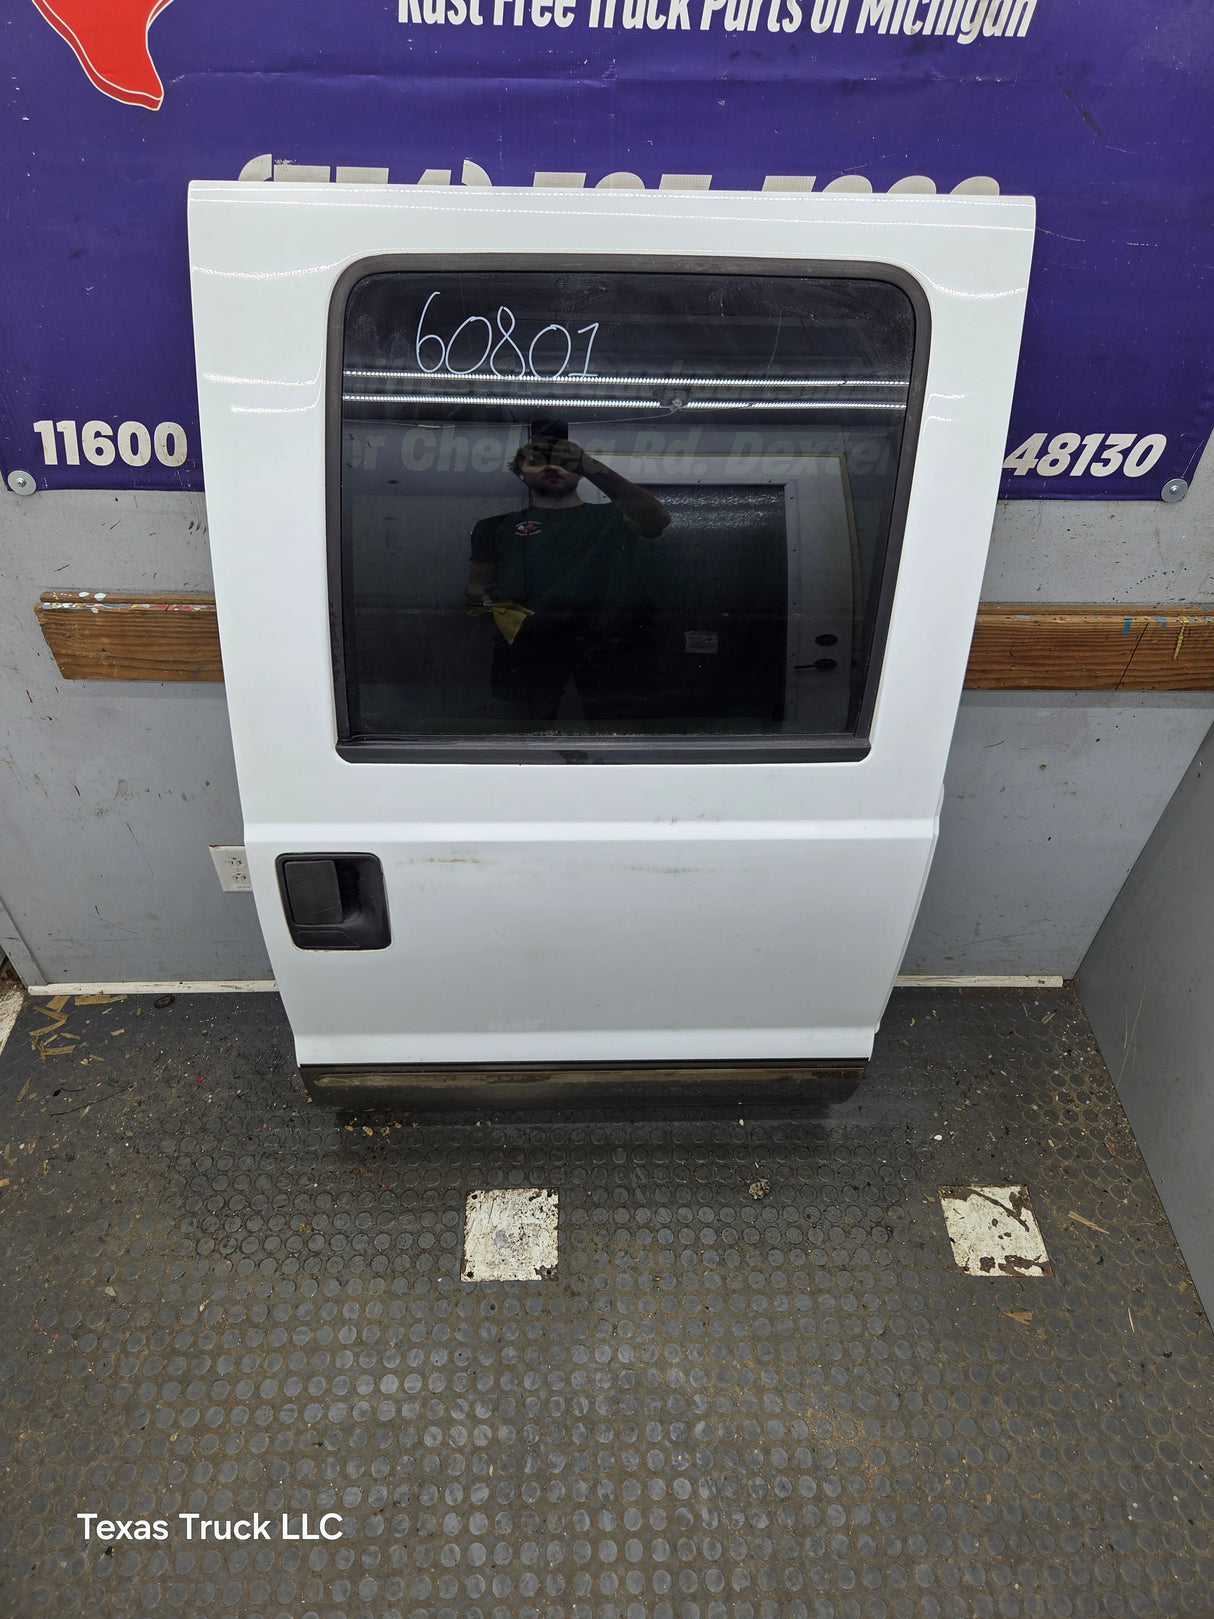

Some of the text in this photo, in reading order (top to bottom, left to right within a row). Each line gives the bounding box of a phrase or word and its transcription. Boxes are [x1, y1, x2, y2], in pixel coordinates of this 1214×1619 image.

[855, 0, 1037, 45] Michigan
[416, 291, 599, 381] 60801
[33, 420, 188, 467] 11600
[628, 427, 709, 476] Rd.
[1002, 432, 1168, 478] 48130
